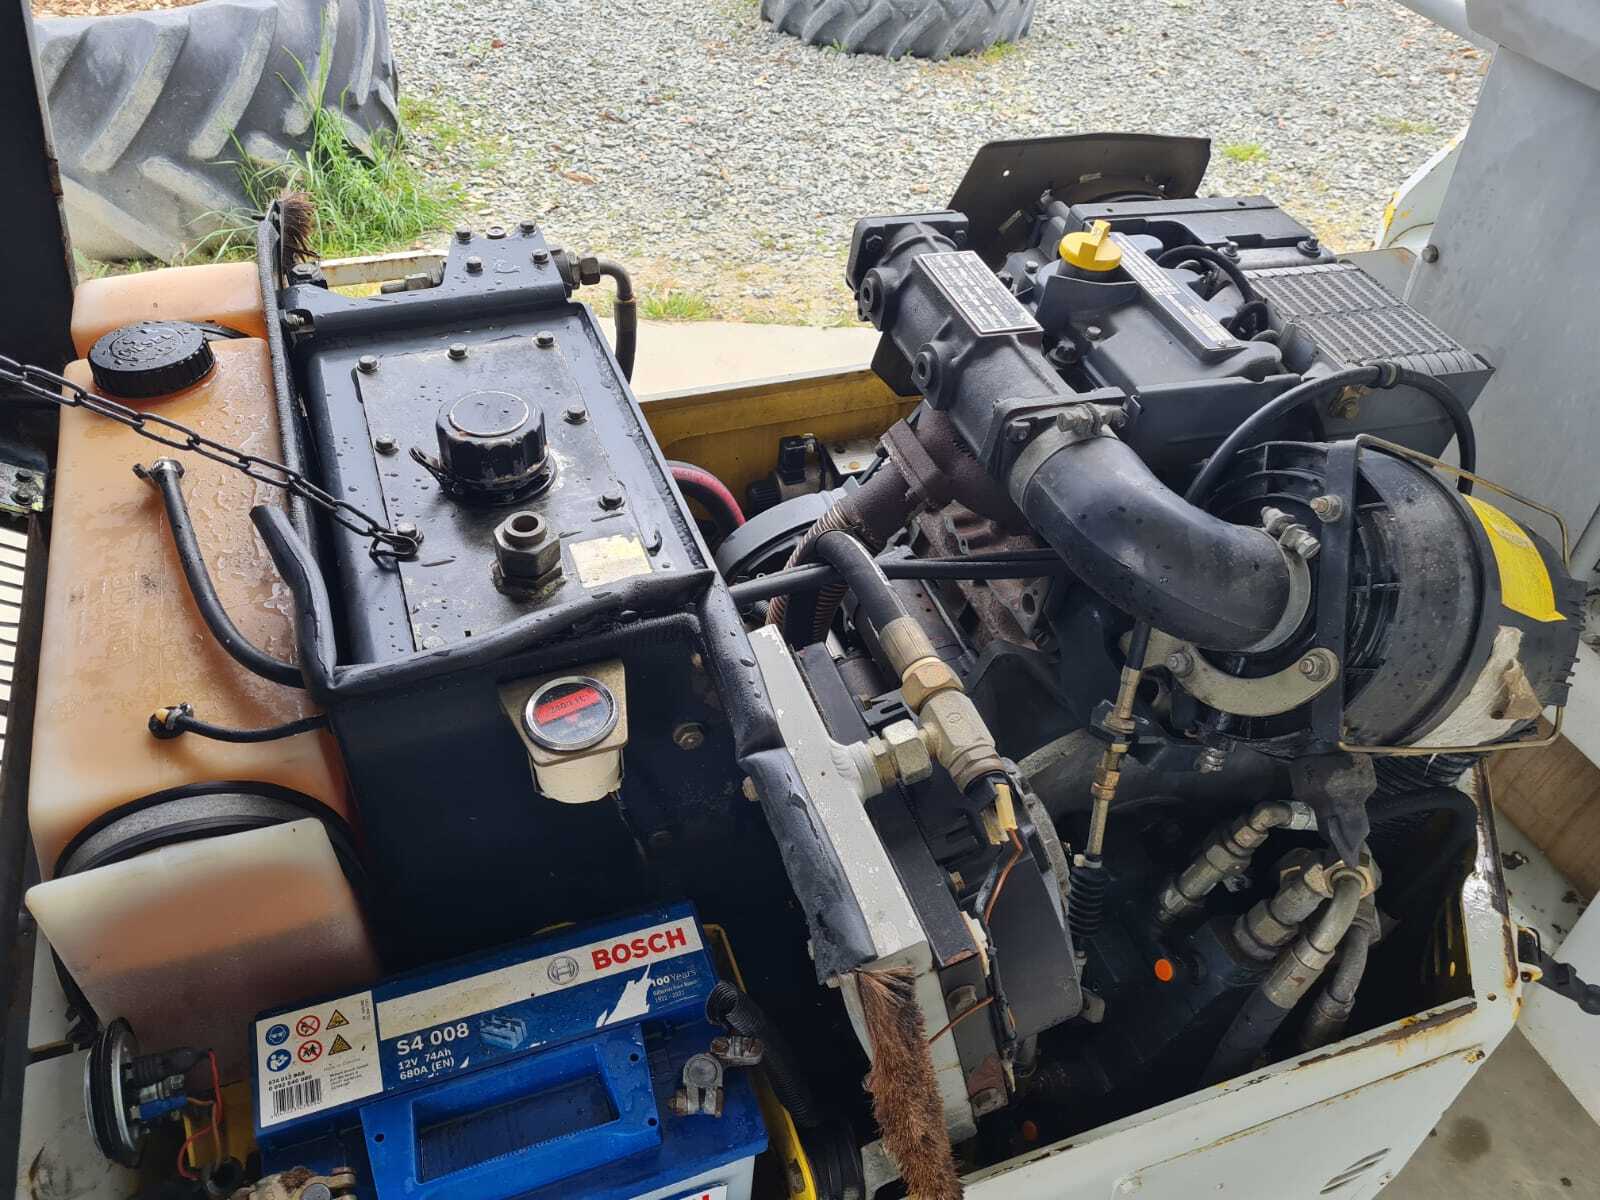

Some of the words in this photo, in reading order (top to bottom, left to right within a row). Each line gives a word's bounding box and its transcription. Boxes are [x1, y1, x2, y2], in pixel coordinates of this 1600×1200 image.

[591, 927, 687, 970] BOSCH
[397, 1035, 424, 1055] S4
[430, 1022, 469, 1045] 008
[398, 1057, 418, 1070] 12V
[424, 1047, 452, 1062] 74Ah
[400, 1065, 428, 1080] 680A
[431, 1056, 455, 1072] (EN)
